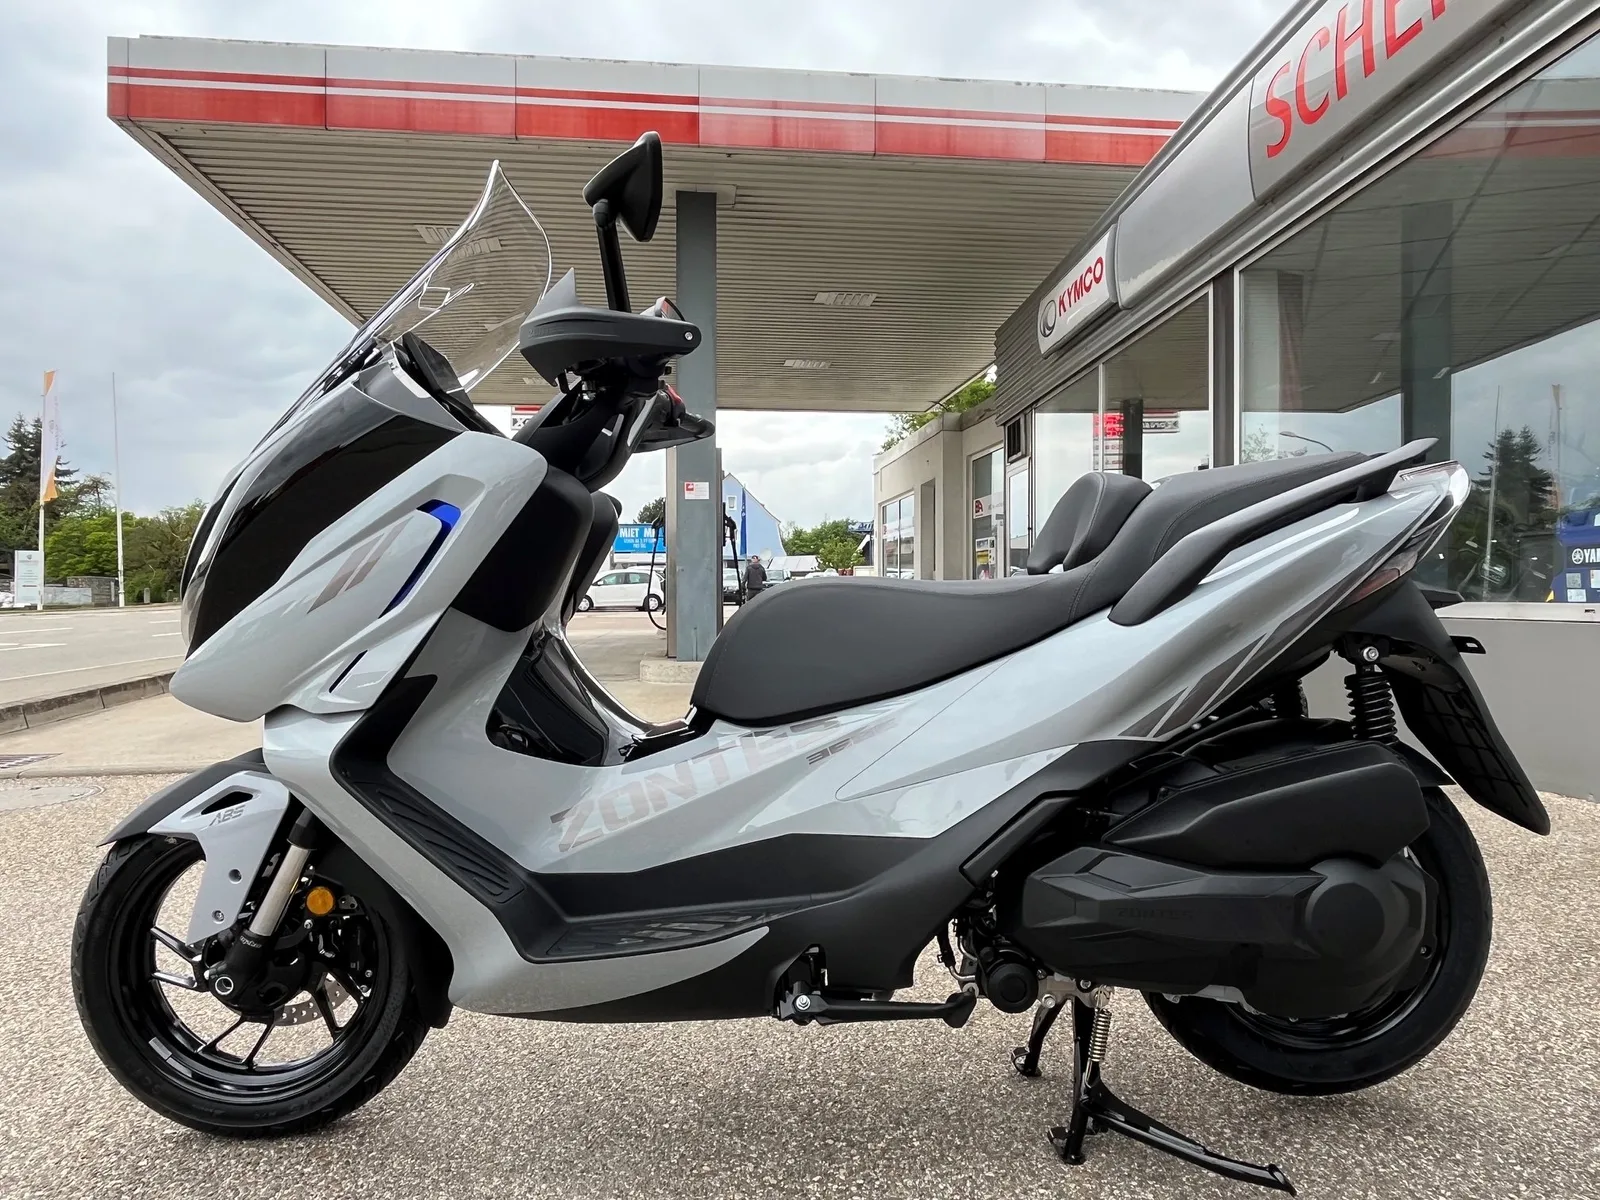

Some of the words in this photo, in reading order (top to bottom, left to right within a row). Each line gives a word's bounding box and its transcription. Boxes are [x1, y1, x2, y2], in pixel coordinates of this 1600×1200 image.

[1265, 0, 1447, 159] SCHE
[1057, 256, 1104, 318] KYMCO
[619, 527, 640, 538] MIET
[549, 715, 843, 853] ZONTES
[208, 804, 246, 827] ABS
